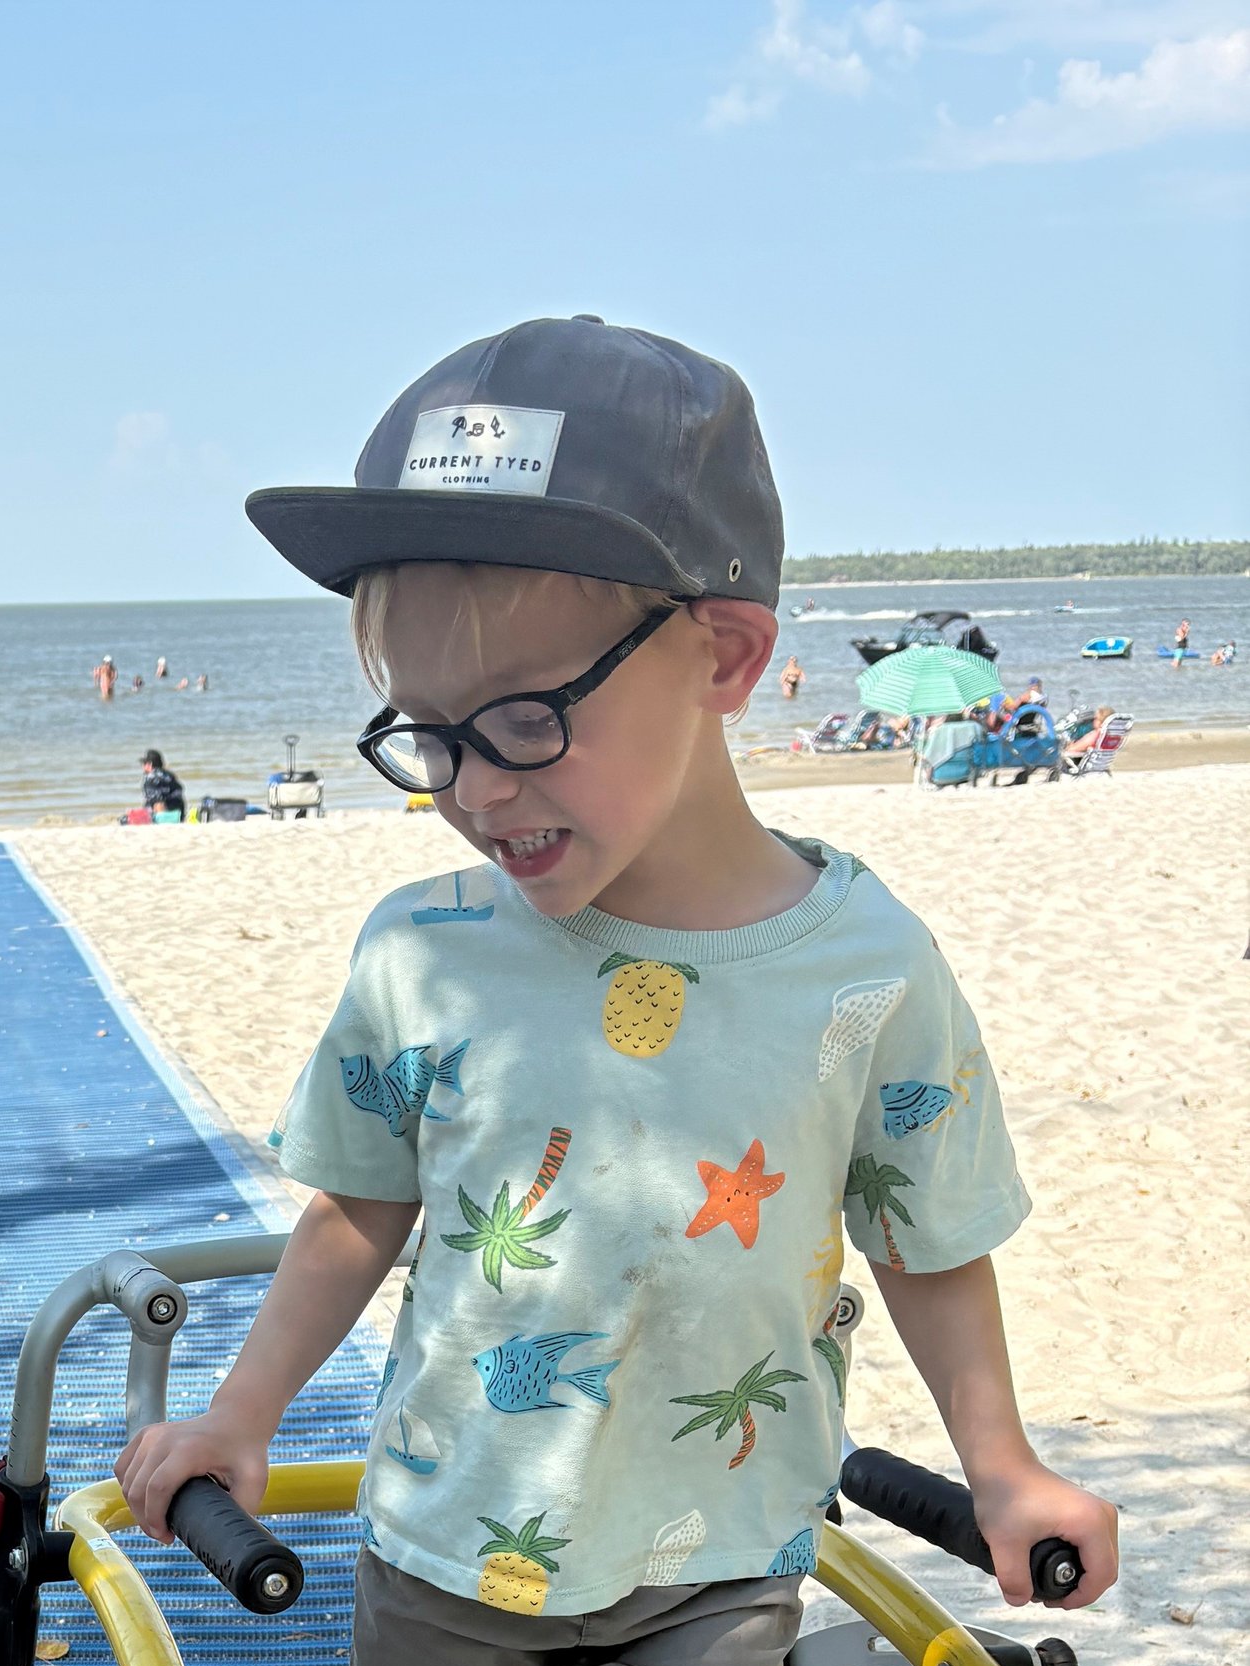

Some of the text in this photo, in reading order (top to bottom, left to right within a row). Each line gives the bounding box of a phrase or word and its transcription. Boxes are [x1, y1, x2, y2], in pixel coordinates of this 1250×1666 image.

[409, 455, 542, 472] CURRENT TYED
[442, 475, 490, 484] CLOTHING
